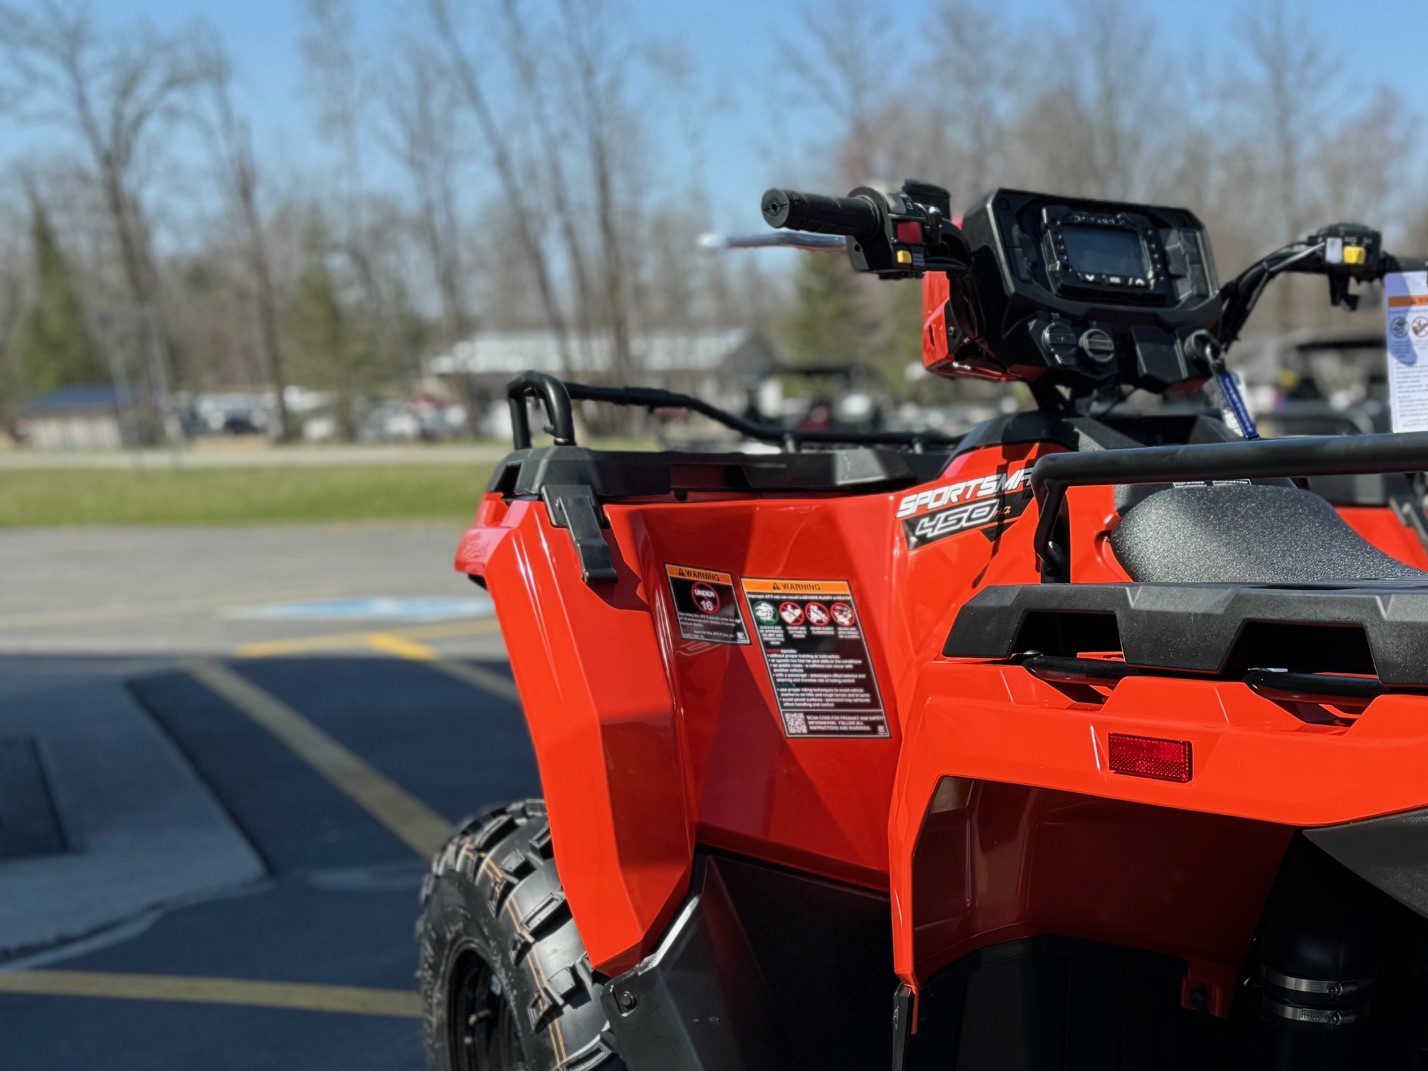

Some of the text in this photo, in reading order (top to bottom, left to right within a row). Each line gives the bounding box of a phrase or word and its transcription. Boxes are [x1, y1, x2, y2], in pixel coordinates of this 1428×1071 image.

[896, 468, 1032, 518] SPORTSMA
[915, 499, 999, 537] 450
[685, 570, 720, 581] WARNING
[782, 583, 821, 591] WARNING
[694, 589, 715, 597] UNDER
[701, 600, 713, 611] 16
